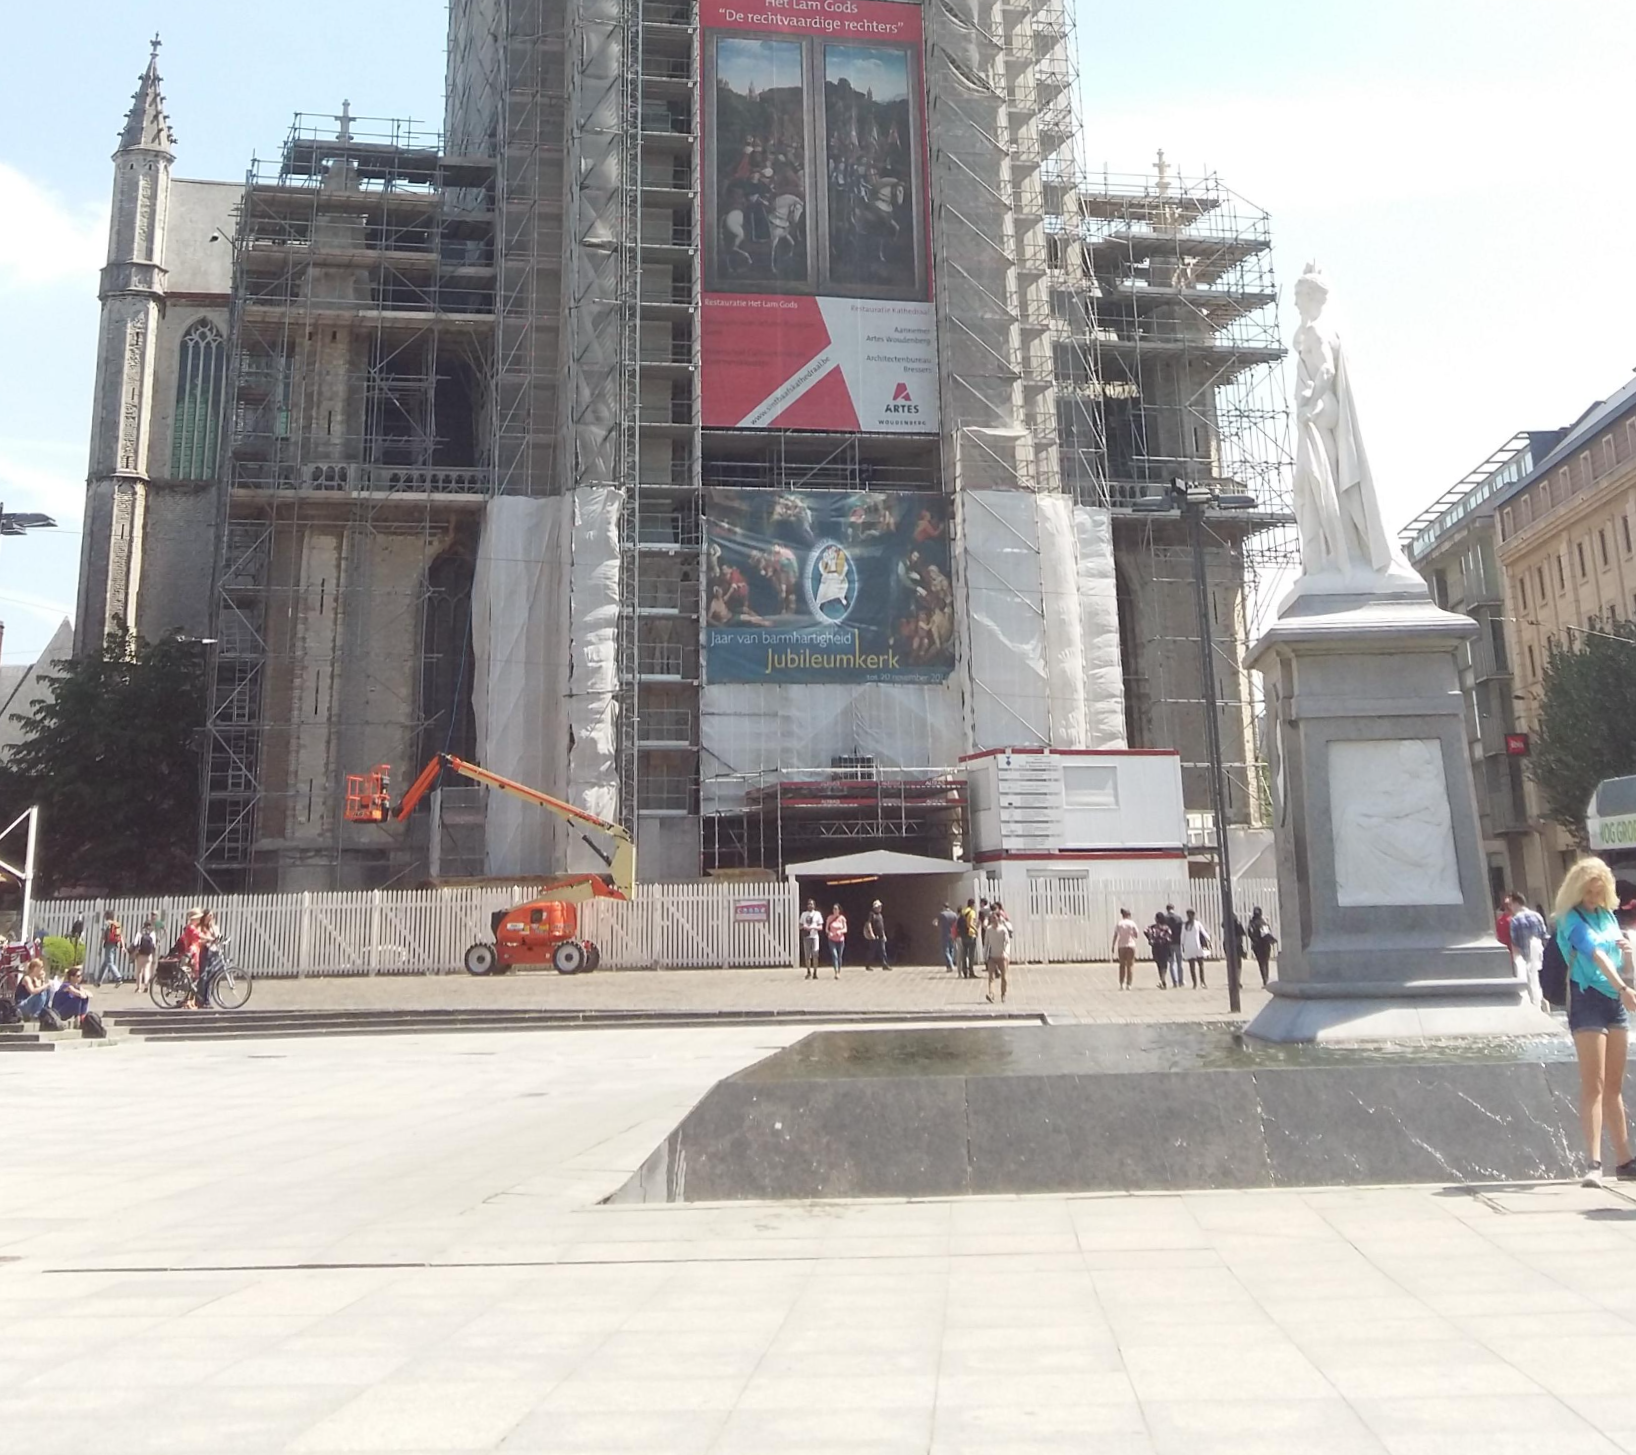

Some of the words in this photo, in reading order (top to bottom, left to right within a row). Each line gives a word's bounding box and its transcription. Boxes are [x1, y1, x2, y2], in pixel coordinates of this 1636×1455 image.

[824, 0, 858, 14] Gods
[747, 11, 841, 32] rechtvaardige
[704, 298, 747, 307] Restauratie
[748, 299, 761, 307] Het
[762, 300, 779, 308] Lam
[779, 300, 798, 309] Gods
[850, 304, 890, 314] Restauratie
[892, 305, 930, 316] Kathedraal
[866, 335, 885, 343] Artes
[886, 336, 931, 346] Woudenberg
[866, 354, 932, 364] Architectenbureau
[903, 366, 932, 374] Bressers
[750, 356, 831, 425] www.sintbaafskathedraal.be
[885, 404, 920, 414] ARTES
[710, 631, 734, 647] Jaar
[737, 634, 759, 644] van
[762, 630, 852, 648] barmhartigheid
[765, 628, 900, 674] Jubileumkerk
[880, 673, 891, 681] 20
[892, 673, 929, 682] november
